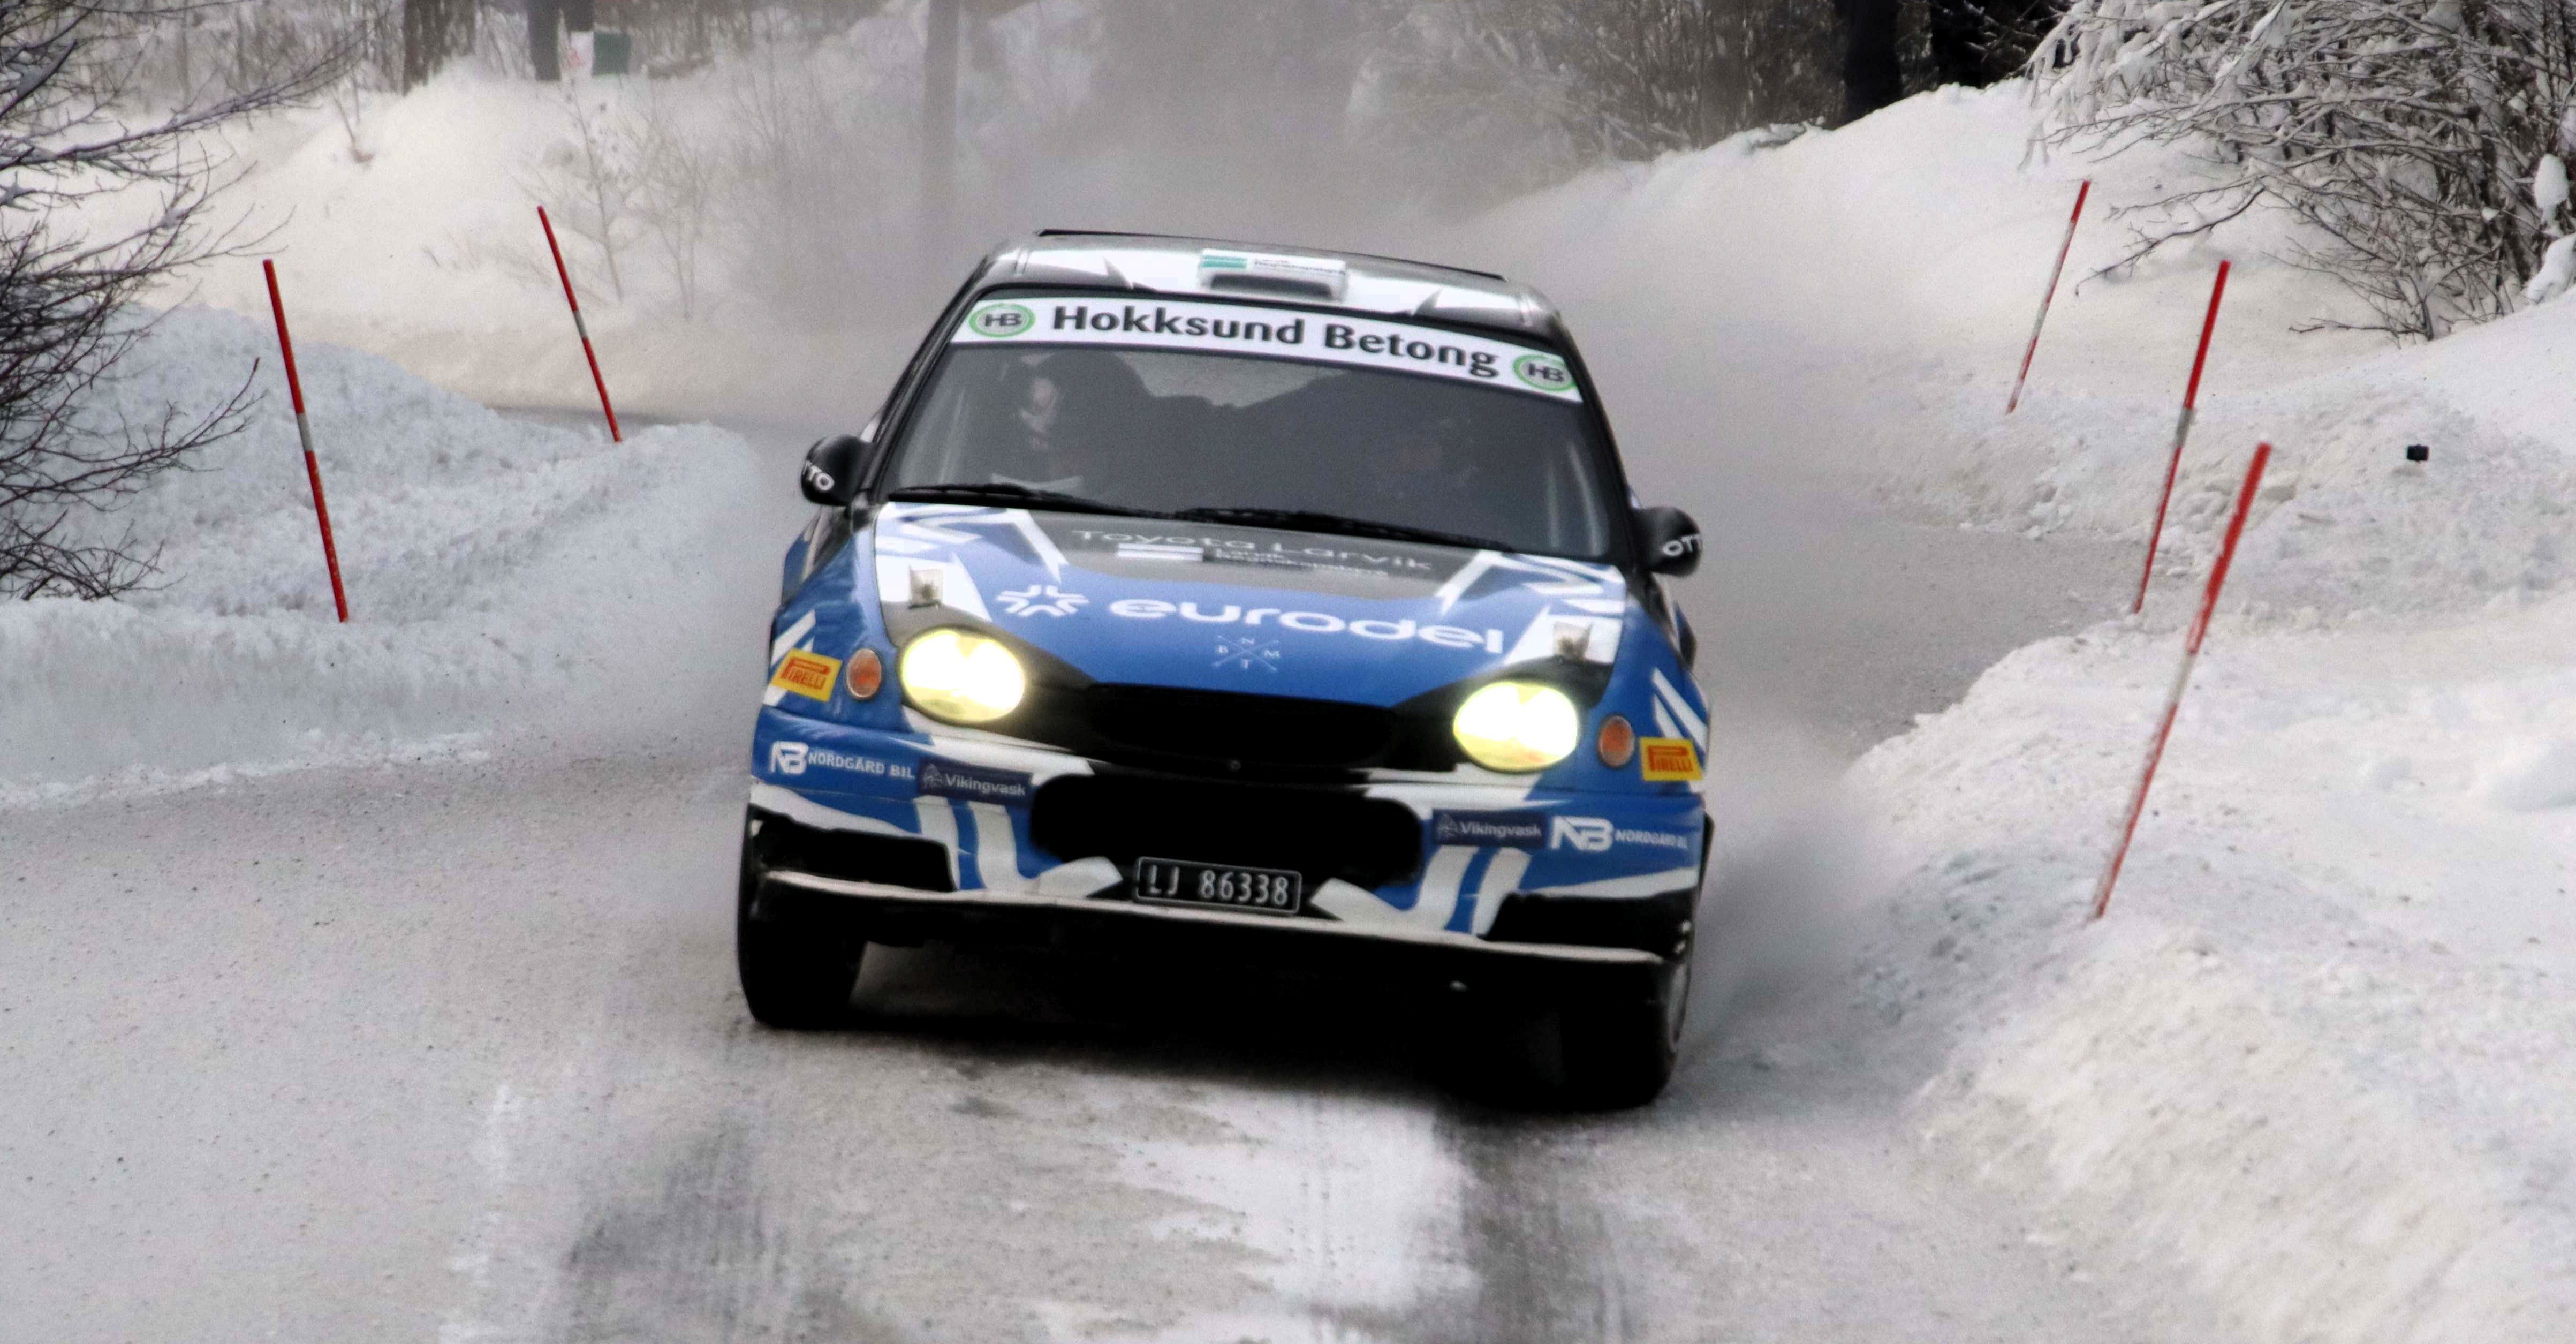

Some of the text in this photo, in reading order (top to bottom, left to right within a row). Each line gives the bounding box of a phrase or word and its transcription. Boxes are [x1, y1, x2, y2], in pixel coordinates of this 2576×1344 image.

[984, 313, 1022, 327] HB
[1052, 305, 1499, 378] Hokksund Betong
[1528, 363, 1565, 382] HB
[1072, 530, 1255, 549] Toyota
[1274, 542, 1431, 570] Larvik
[1110, 598, 1503, 654] eurodel
[779, 656, 830, 690] PIRELLI
[769, 741, 916, 779] NB NORDGÅRD BIL
[945, 773, 1026, 796] Vikingvask
[1460, 821, 1542, 839] Vikingvask
[1550, 816, 1614, 851] NB
[1149, 864, 1289, 906] LJ 86338
